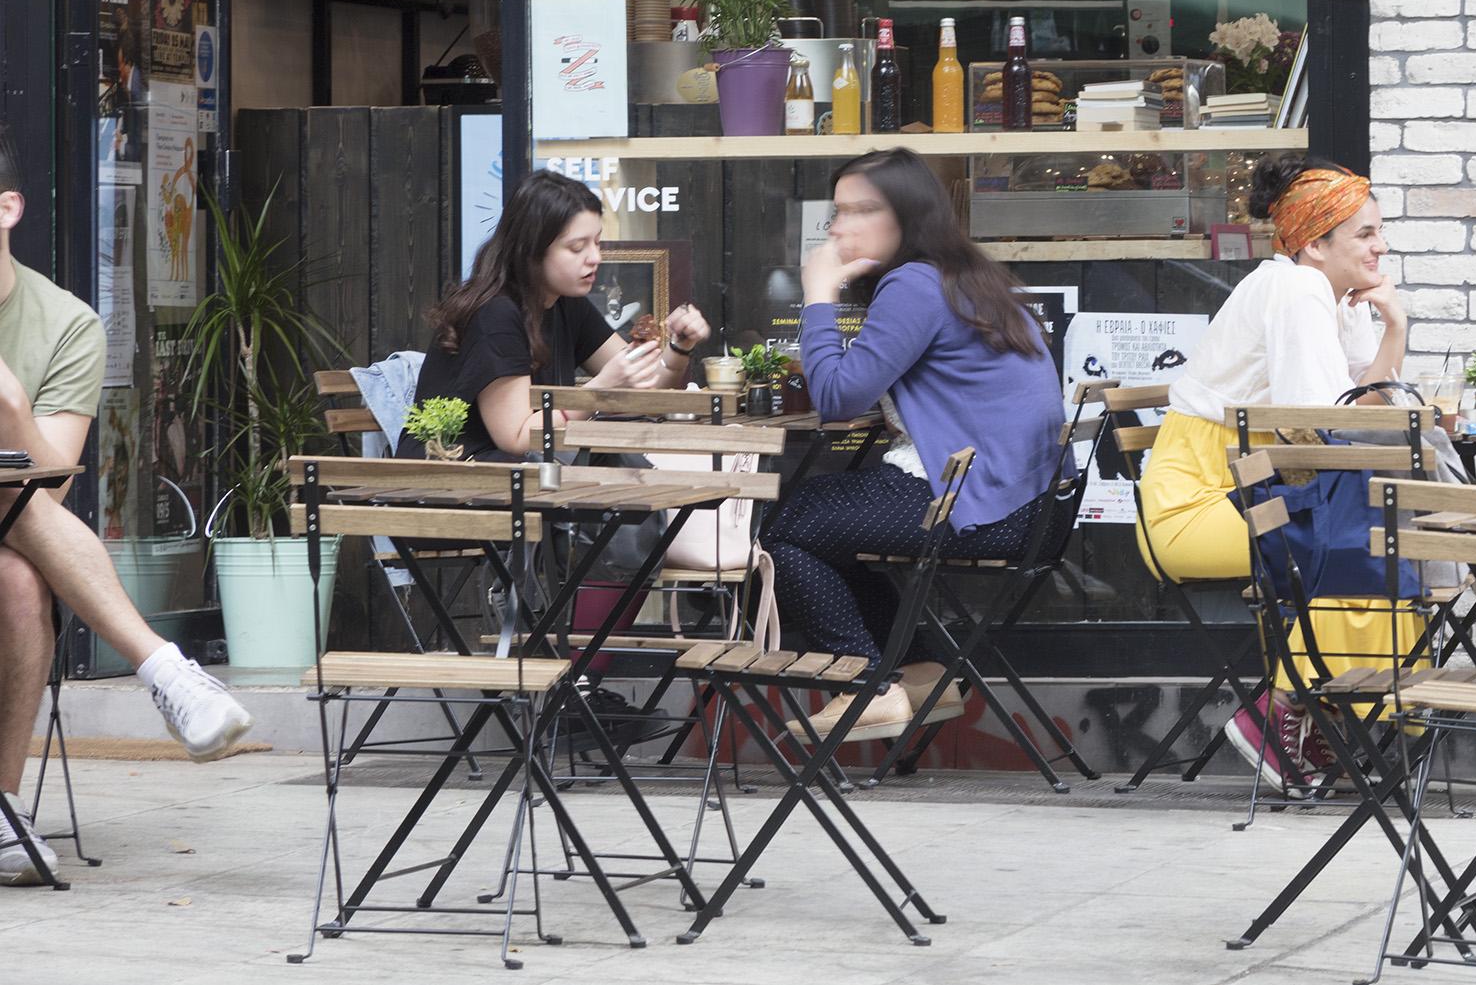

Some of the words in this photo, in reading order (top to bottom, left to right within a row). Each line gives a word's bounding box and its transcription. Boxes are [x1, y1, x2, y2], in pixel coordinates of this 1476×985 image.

[546, 157, 620, 182] SELF
[590, 186, 680, 213] VICE
[1096, 320, 1102, 334] Η
[1104, 320, 1132, 335] ΕΒΡΑΙΑ
[1140, 320, 1146, 335] Ο
[1149, 320, 1176, 335] ΧΑΦΙΕΣ
